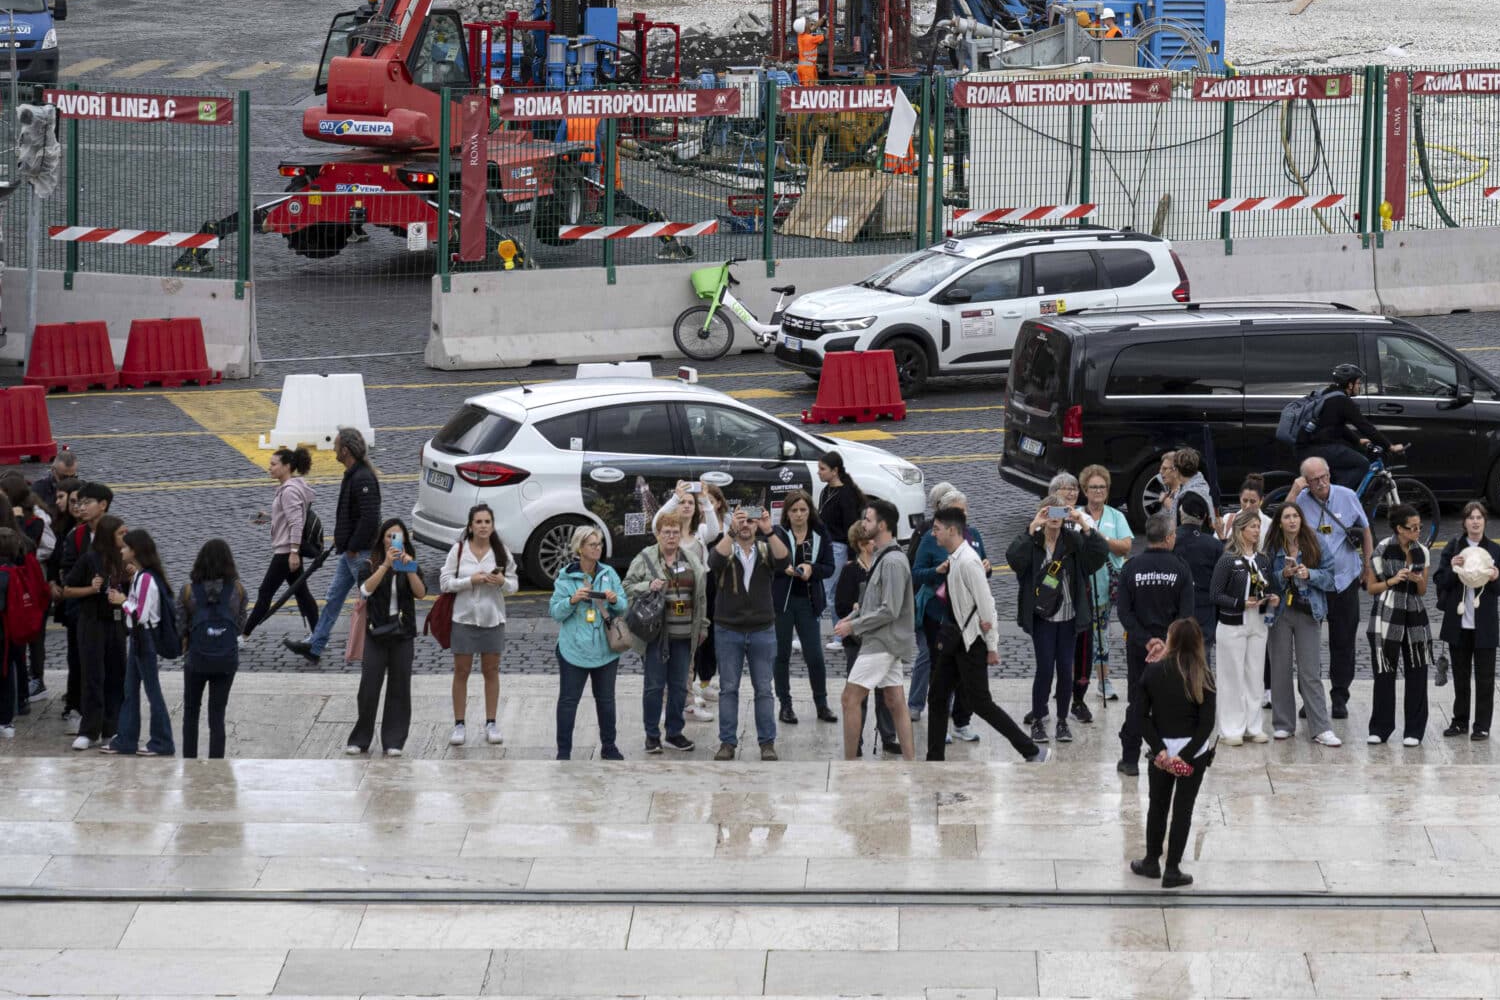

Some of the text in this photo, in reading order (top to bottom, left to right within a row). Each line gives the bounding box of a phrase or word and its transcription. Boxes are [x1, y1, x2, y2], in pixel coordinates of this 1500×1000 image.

[966, 82, 1132, 103] ROMA METROPOLITANE
[1201, 78, 1307, 97] LAVORI LINEA C
[1423, 75, 1462, 91] ROMA
[47, 94, 176, 118] LAVORI LINEA C
[513, 94, 697, 116] ROMA METROPOLITANE
[790, 89, 894, 109] LAVORI LINEA
[319, 122, 392, 133] GV3 VENPA
[1393, 107, 1401, 136] ROMA
[470, 133, 479, 166] ROMA
[290, 203, 299, 212] 40
[1135, 571, 1178, 582] Battistolli
